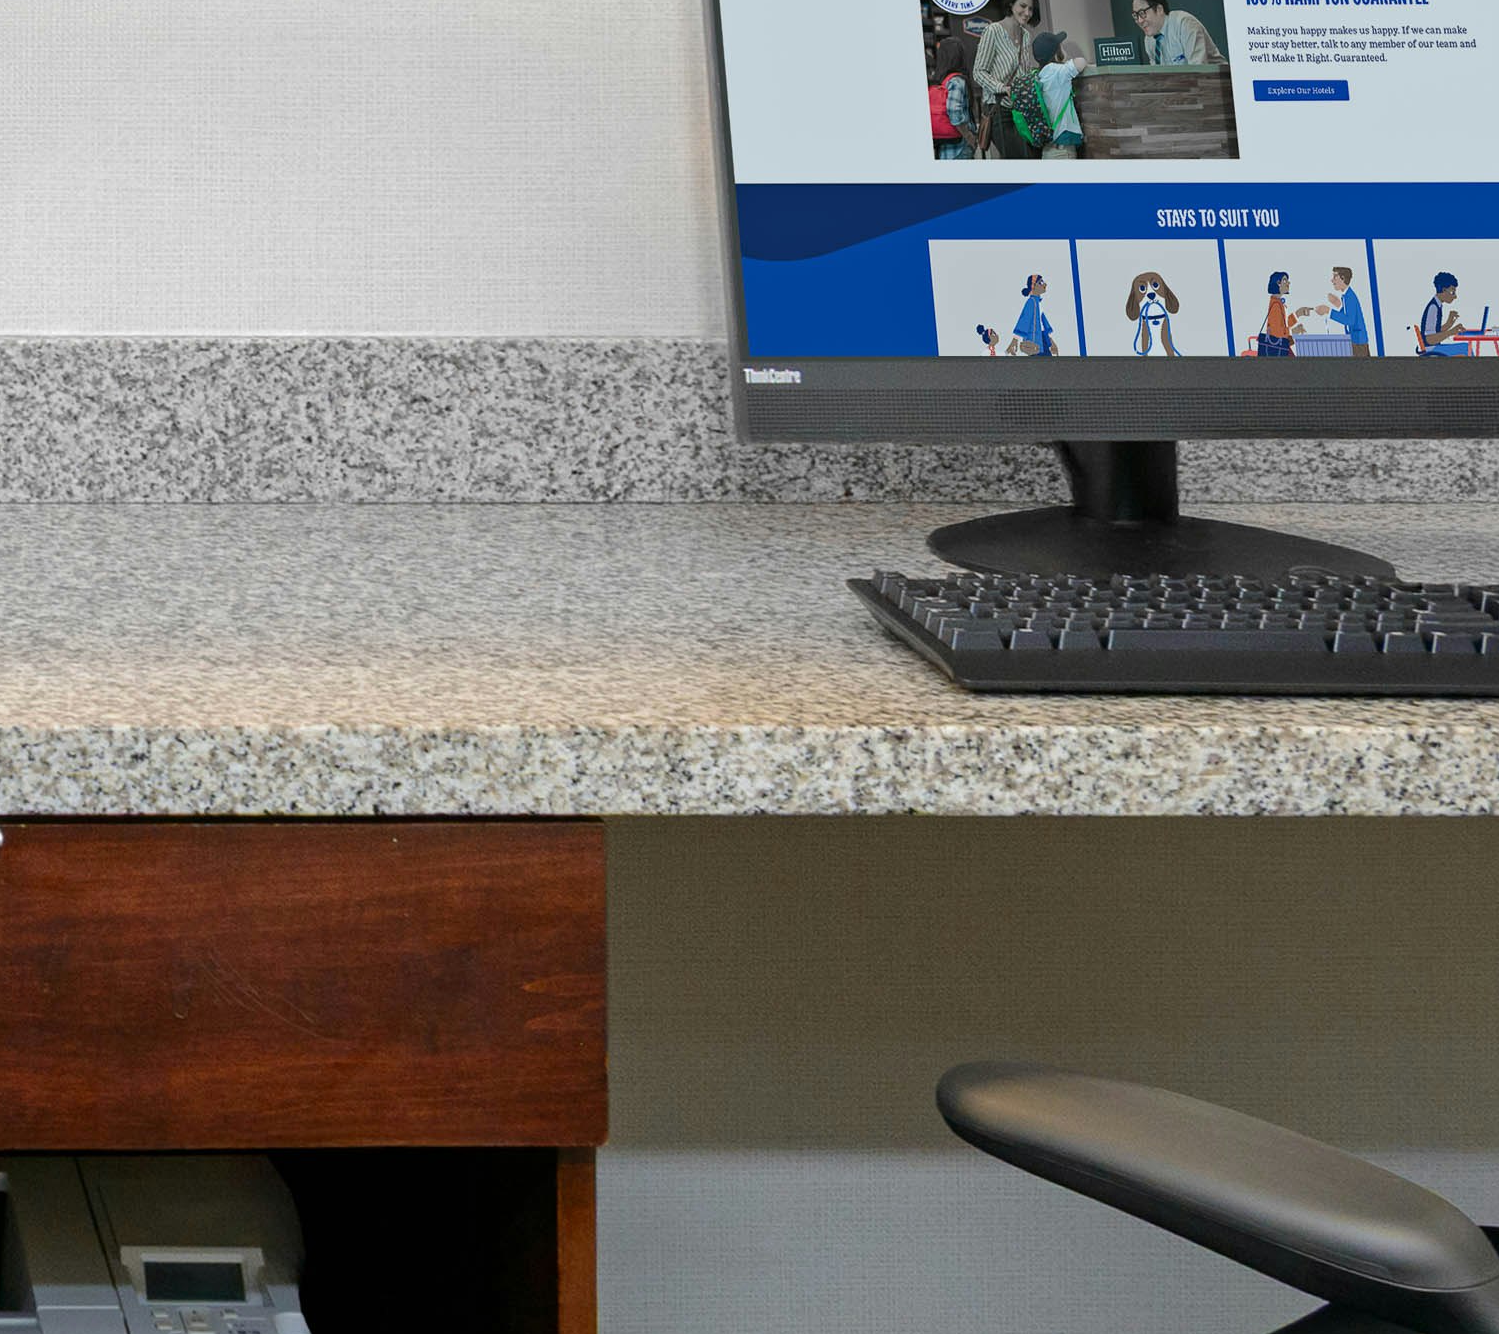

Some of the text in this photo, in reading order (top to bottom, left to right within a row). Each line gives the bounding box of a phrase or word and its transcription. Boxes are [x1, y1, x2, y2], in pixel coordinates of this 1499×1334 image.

[1246, 24, 1468, 38] Making you happy makes us happy. If we can make
[1101, 46, 1132, 57] Hilton
[1248, 38, 1477, 52] your stay better, talk to any member of our team and
[1249, 52, 1388, 65] we'll Make It Right. Guaranteed.
[1157, 209, 1279, 227] STAYS TO SUIT YOU
